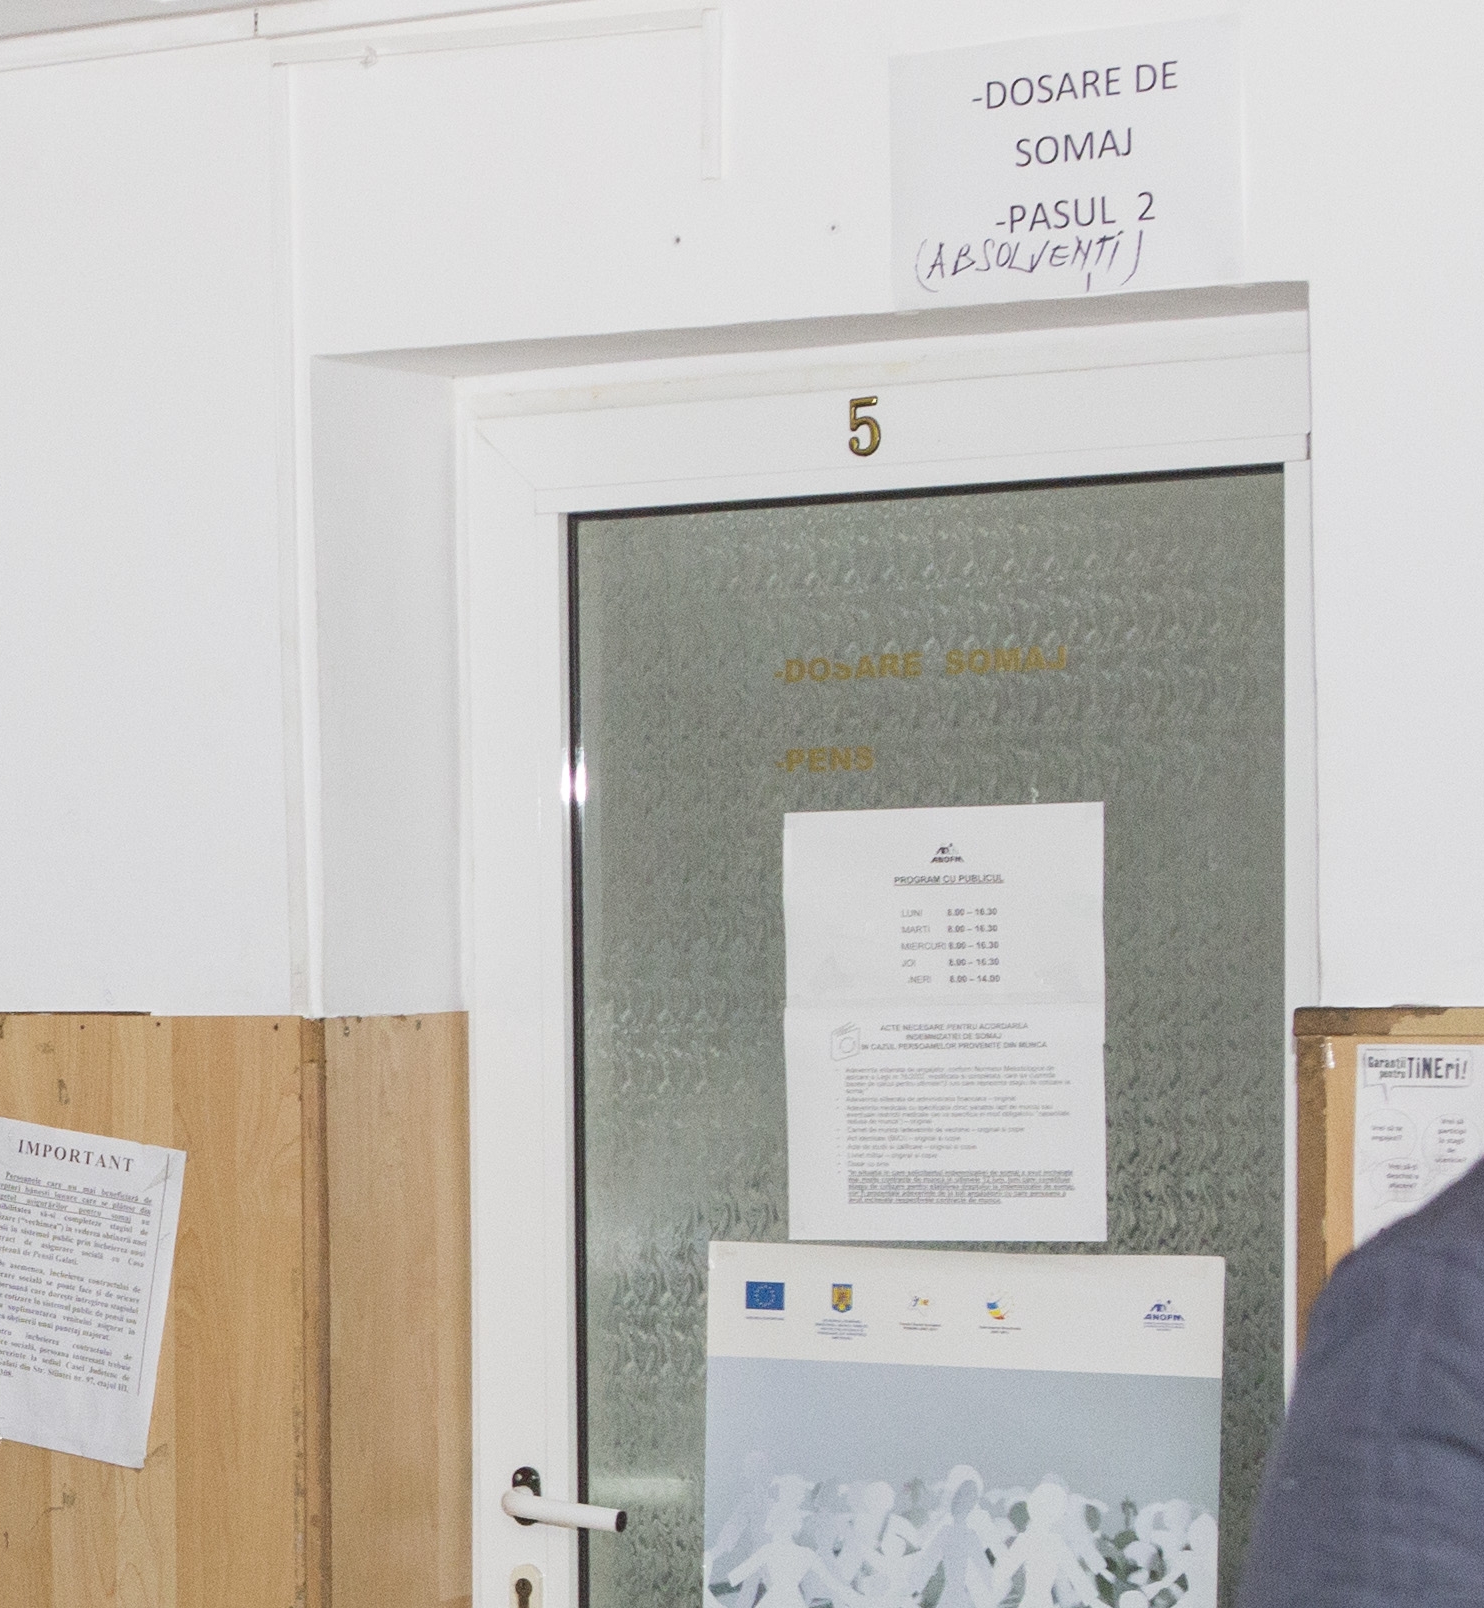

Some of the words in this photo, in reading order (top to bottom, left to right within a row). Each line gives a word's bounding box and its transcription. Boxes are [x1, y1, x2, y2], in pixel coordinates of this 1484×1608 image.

[972, 67, 1121, 110] -DOSARE
[1136, 60, 1178, 93] DE
[1016, 127, 1132, 168] SOMAJ
[995, 197, 1116, 234] -PASUL
[1138, 191, 1155, 221] 2
[849, 397, 880, 456] 5
[946, 645, 1067, 675] SOMAJ
[893, 875, 941, 884] PROGRAM
[942, 874, 957, 884] CU
[958, 873, 1004, 884] PUBLICUL
[18, 1139, 135, 1172] IMPORTANT
[1144, 1313, 1184, 1321] ANOFM
